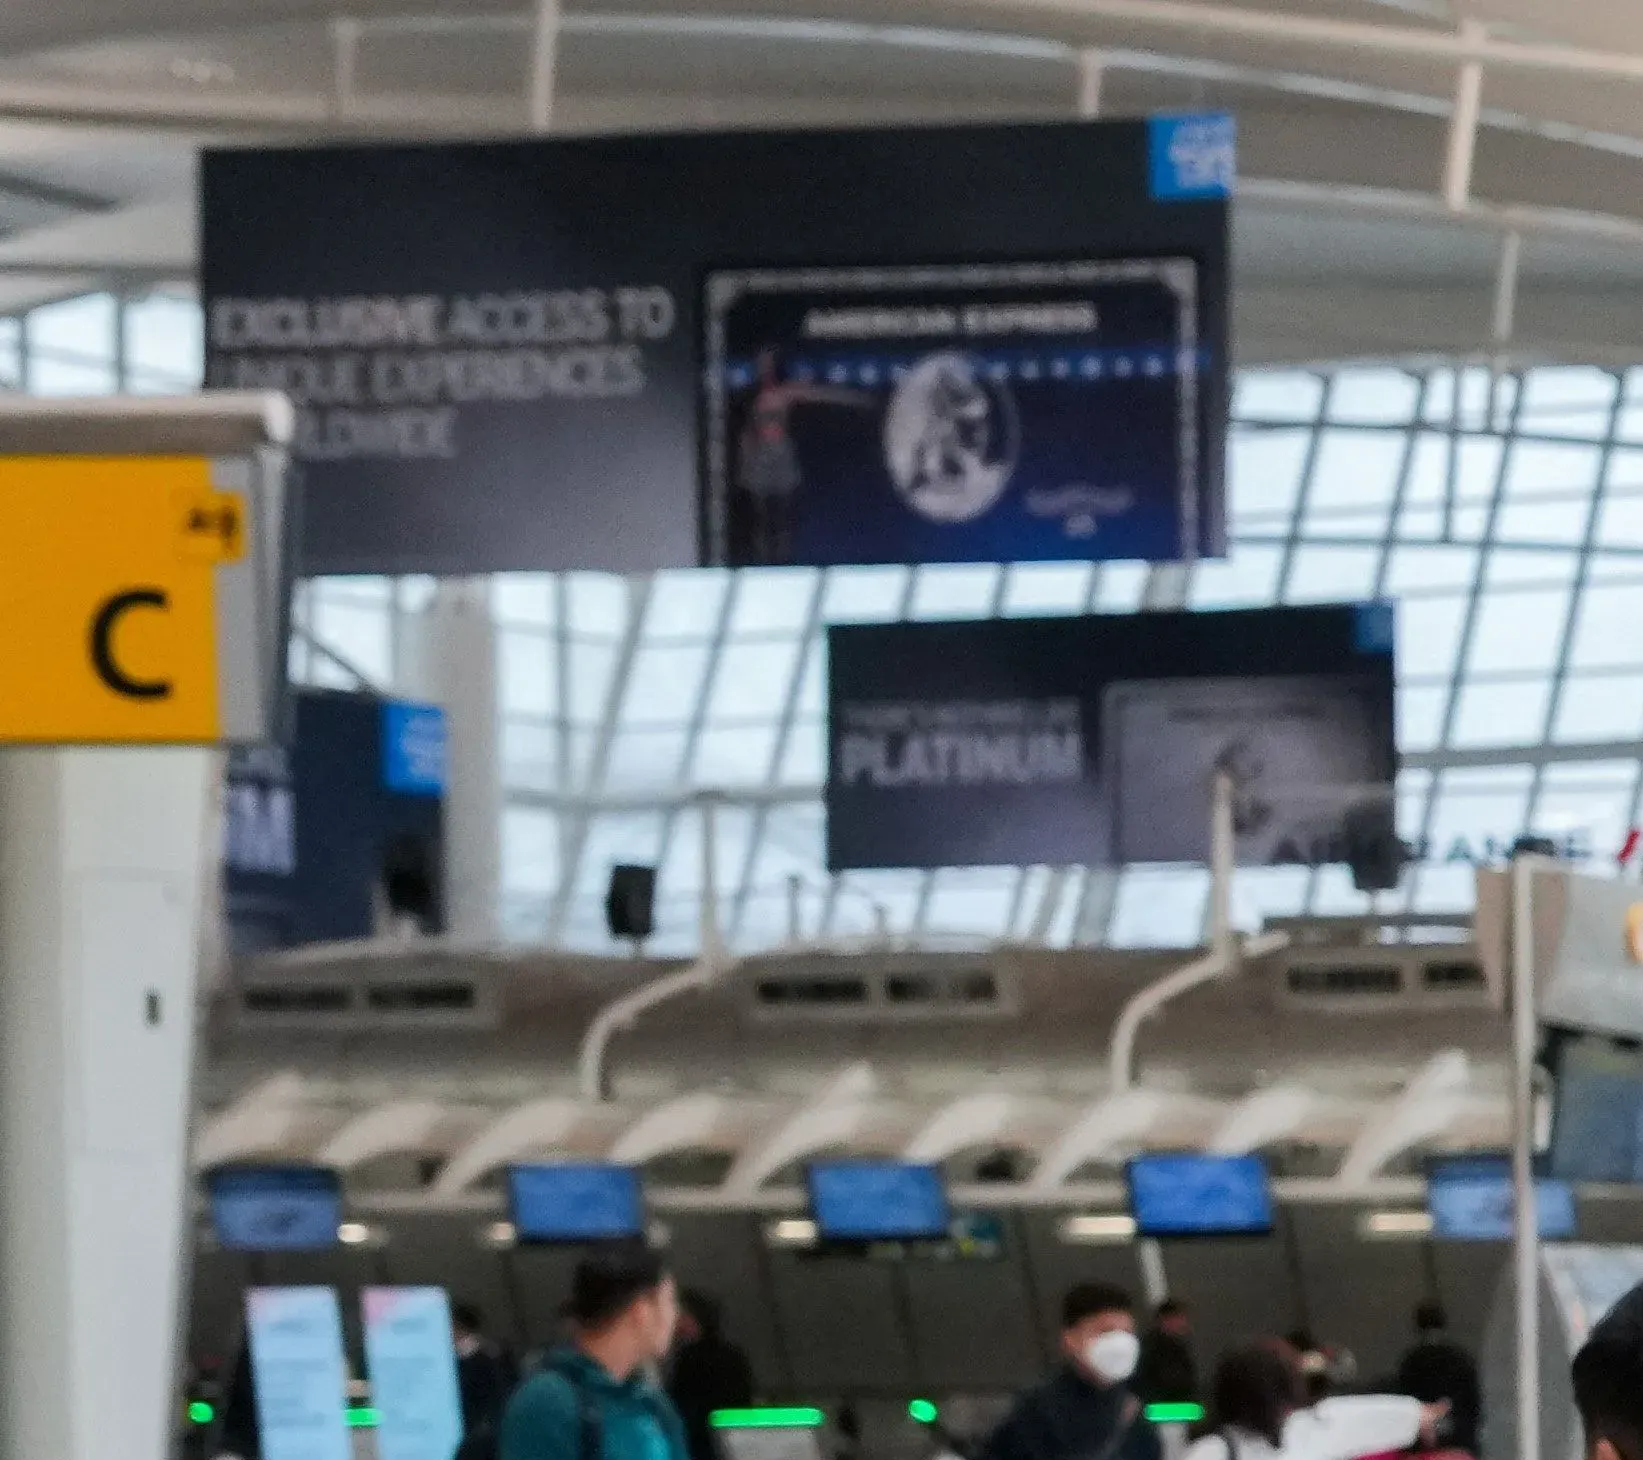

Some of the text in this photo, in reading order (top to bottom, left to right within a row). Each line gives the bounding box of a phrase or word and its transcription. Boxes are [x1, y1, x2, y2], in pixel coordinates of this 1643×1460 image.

[449, 289, 610, 343] ACCESS
[615, 286, 675, 339] TO
[87, 588, 173, 699] C
[840, 730, 1082, 787] PLATINUM
